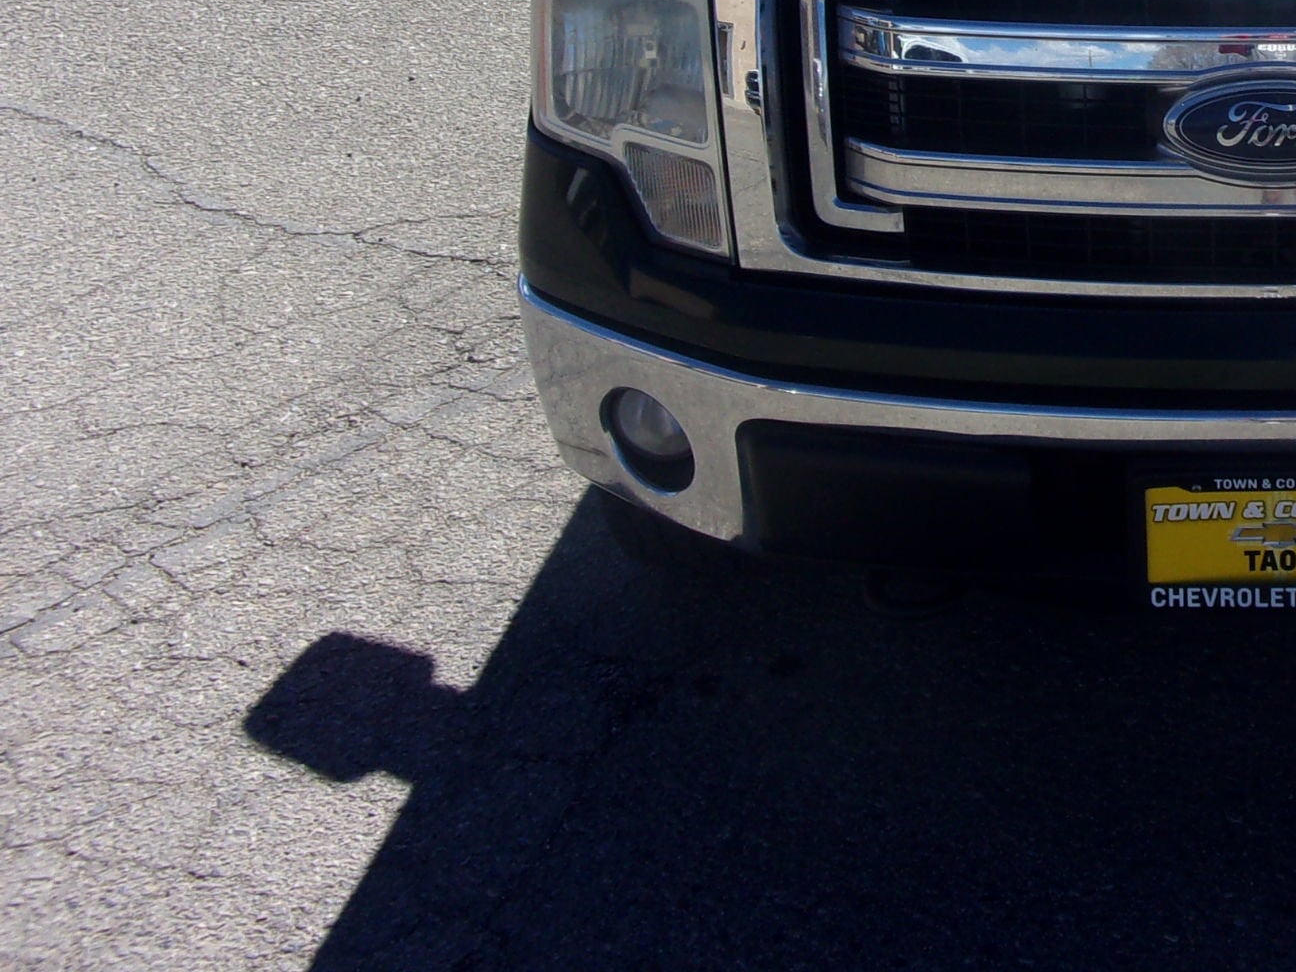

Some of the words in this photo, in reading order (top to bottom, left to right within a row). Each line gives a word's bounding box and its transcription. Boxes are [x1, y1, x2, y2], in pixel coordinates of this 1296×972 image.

[1214, 478, 1258, 490] TOWN
[1261, 478, 1272, 489] &
[1151, 501, 1236, 522] TOWN
[1242, 501, 1266, 519] &
